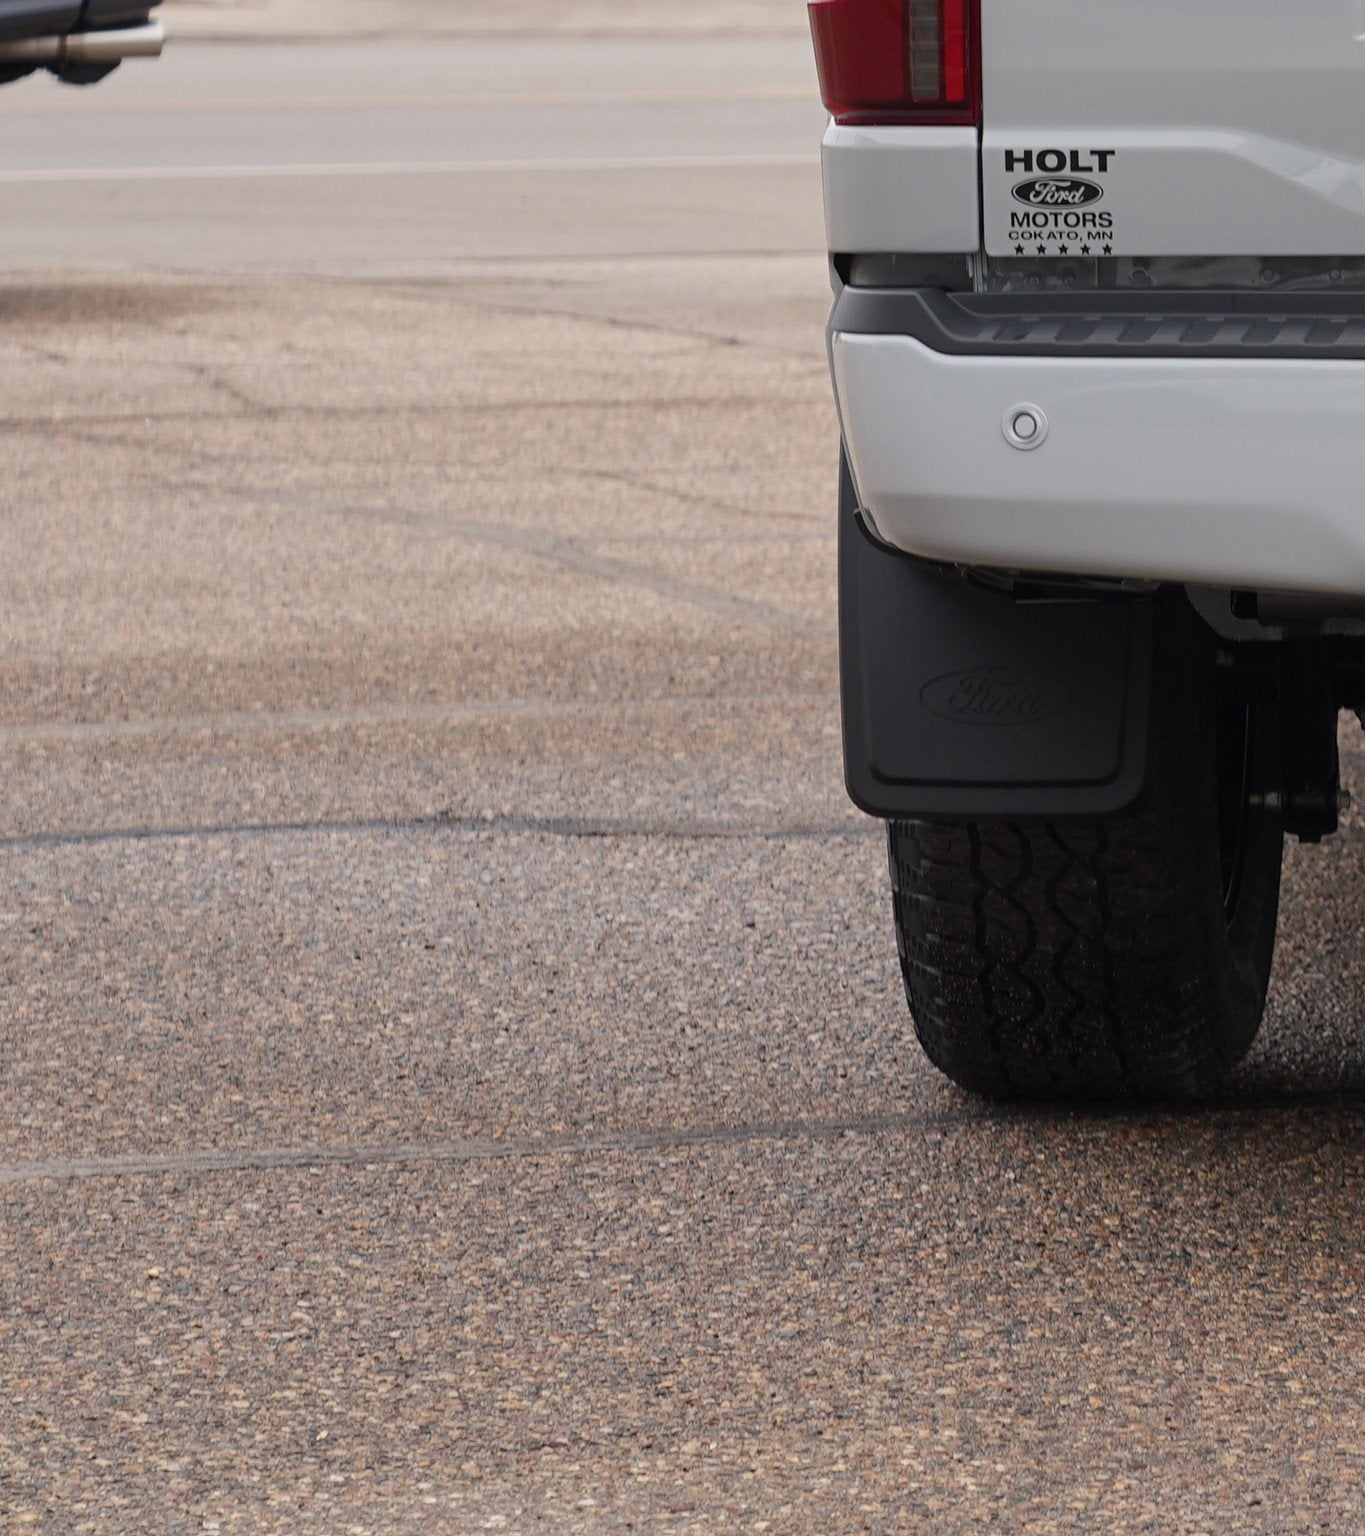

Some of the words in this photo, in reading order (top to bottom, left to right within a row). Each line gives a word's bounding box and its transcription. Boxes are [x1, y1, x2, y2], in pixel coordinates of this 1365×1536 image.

[1004, 149, 1115, 173] HOLT
[1029, 180, 1085, 204] Ford
[1010, 211, 1113, 228] MOTORS
[1008, 231, 1083, 242] COKATO,
[1087, 231, 1113, 241] MN
